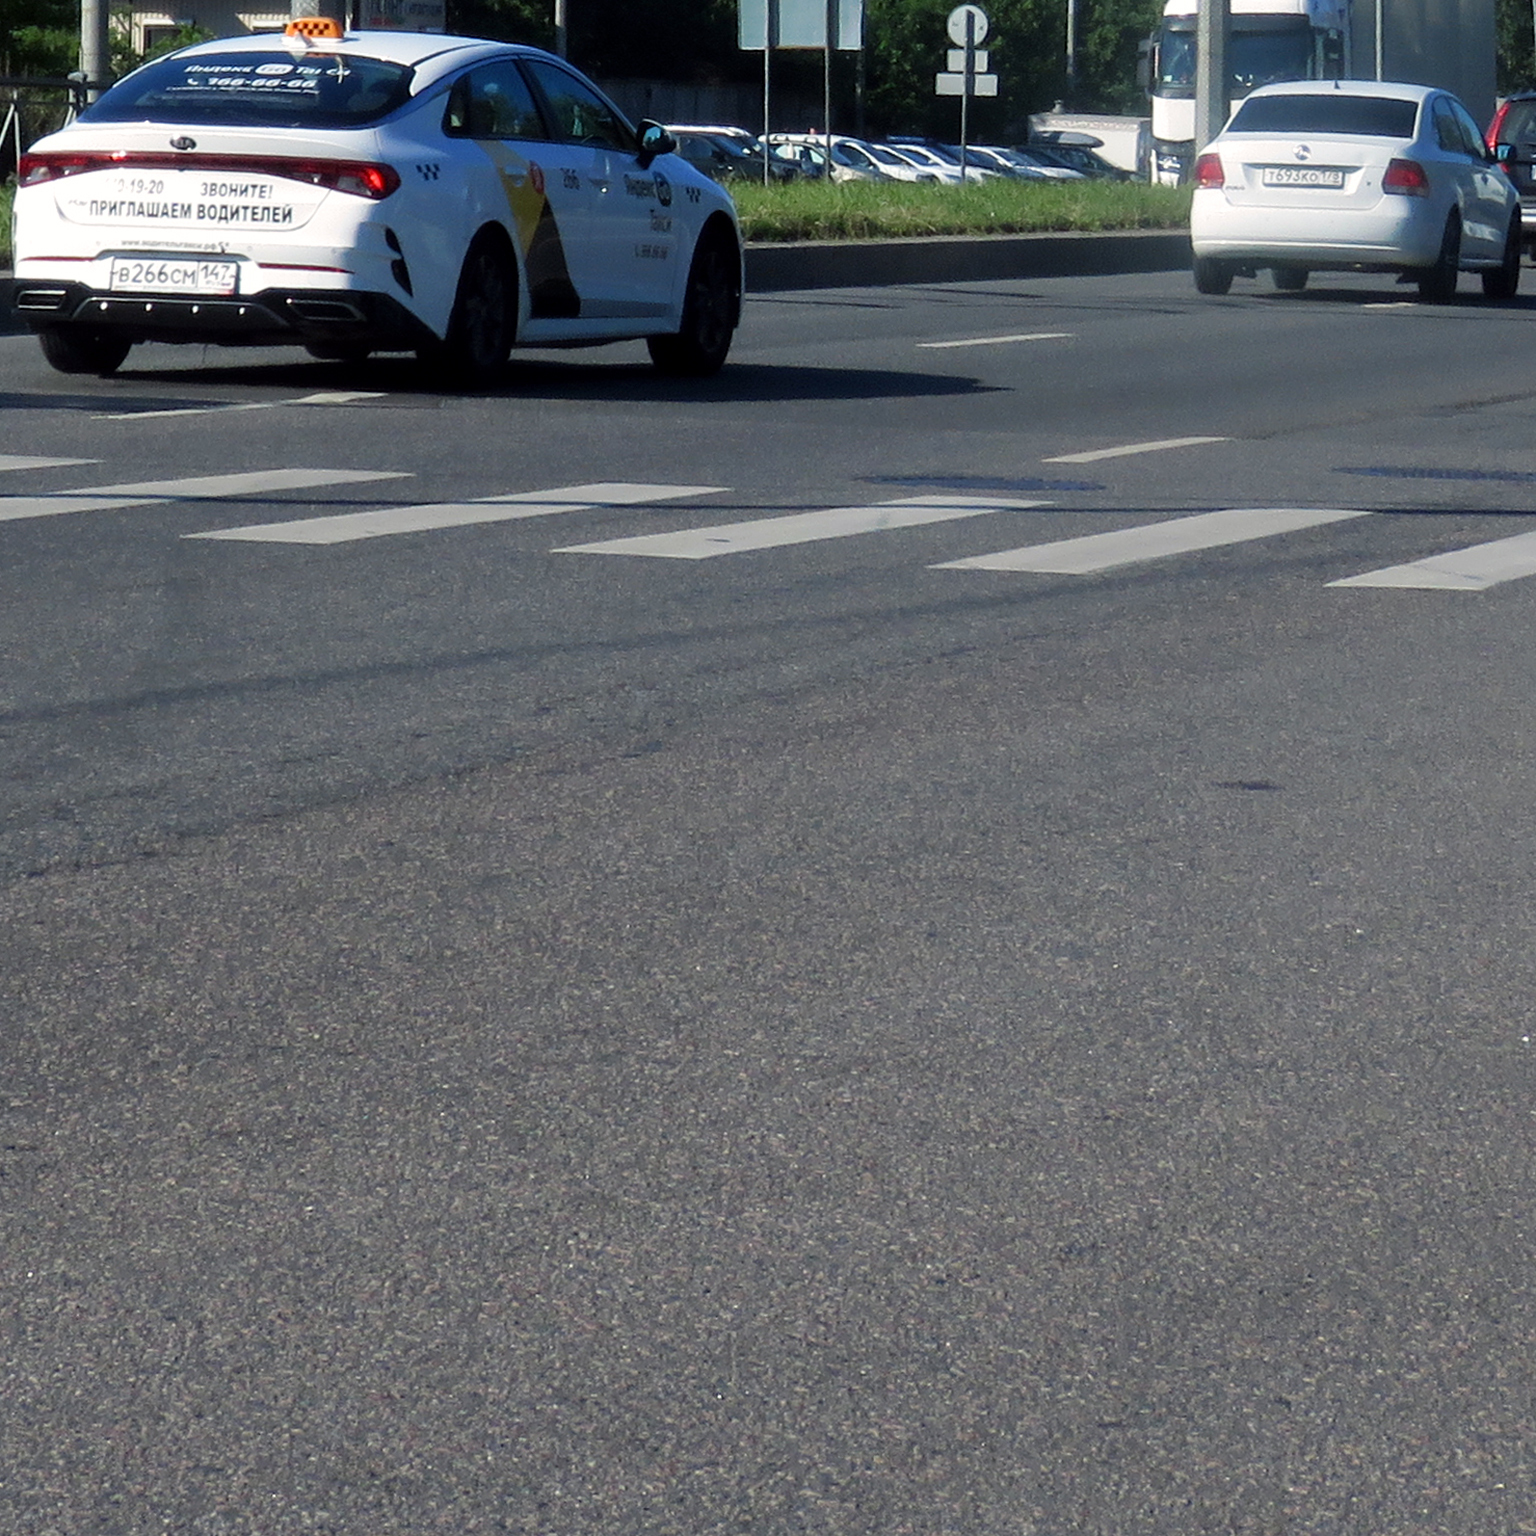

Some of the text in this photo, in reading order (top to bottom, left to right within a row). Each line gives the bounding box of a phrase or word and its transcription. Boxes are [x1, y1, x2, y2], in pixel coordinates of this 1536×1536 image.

[200, 181, 273, 199] ЗВОНИТЕ!
[89, 199, 293, 225] ПРИГЛАШАЕМ ВОДИТЕЛЕЙ
[200, 264, 230, 282] 147
